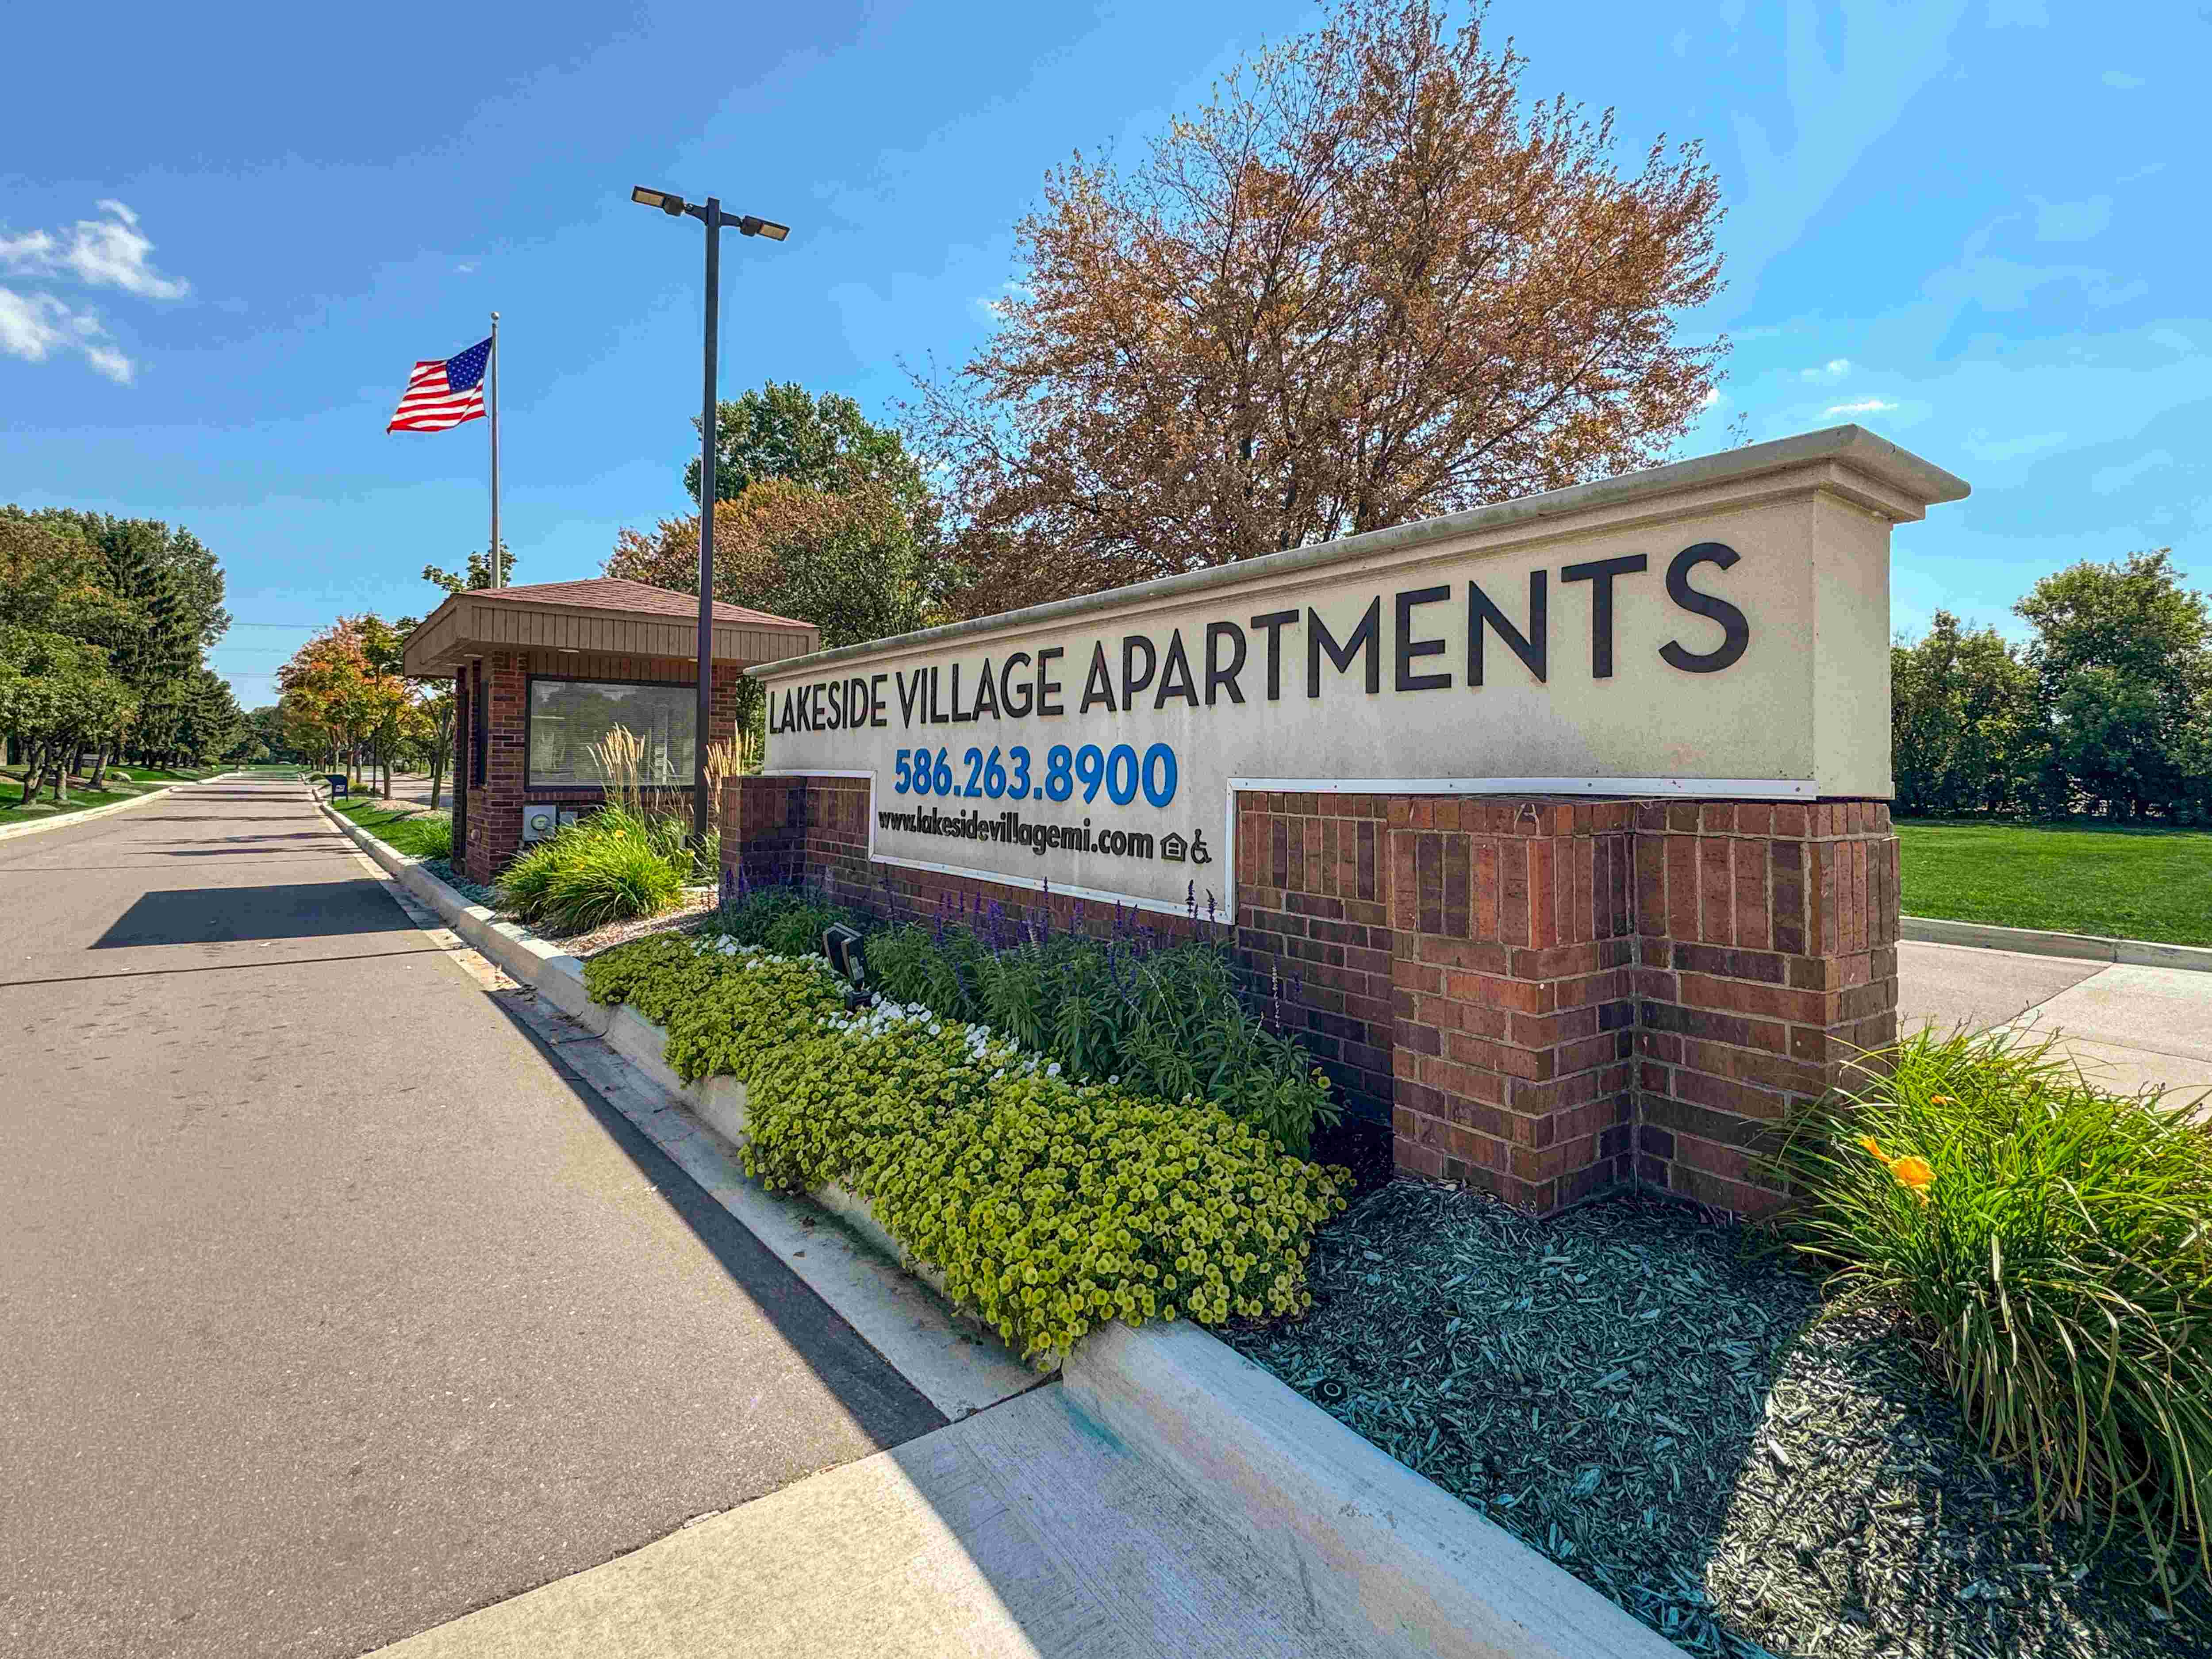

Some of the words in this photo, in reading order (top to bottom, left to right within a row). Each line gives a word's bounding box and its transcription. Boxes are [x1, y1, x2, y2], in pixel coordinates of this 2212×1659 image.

[769, 673, 887, 734] LAKESIDE
[896, 647, 1064, 729] VILLAGE
[1079, 542, 1750, 714] APARTMENTS
[894, 742, 1178, 808] 586.263.8900
[878, 805, 1154, 859] www.lakesidevillagemi.com
